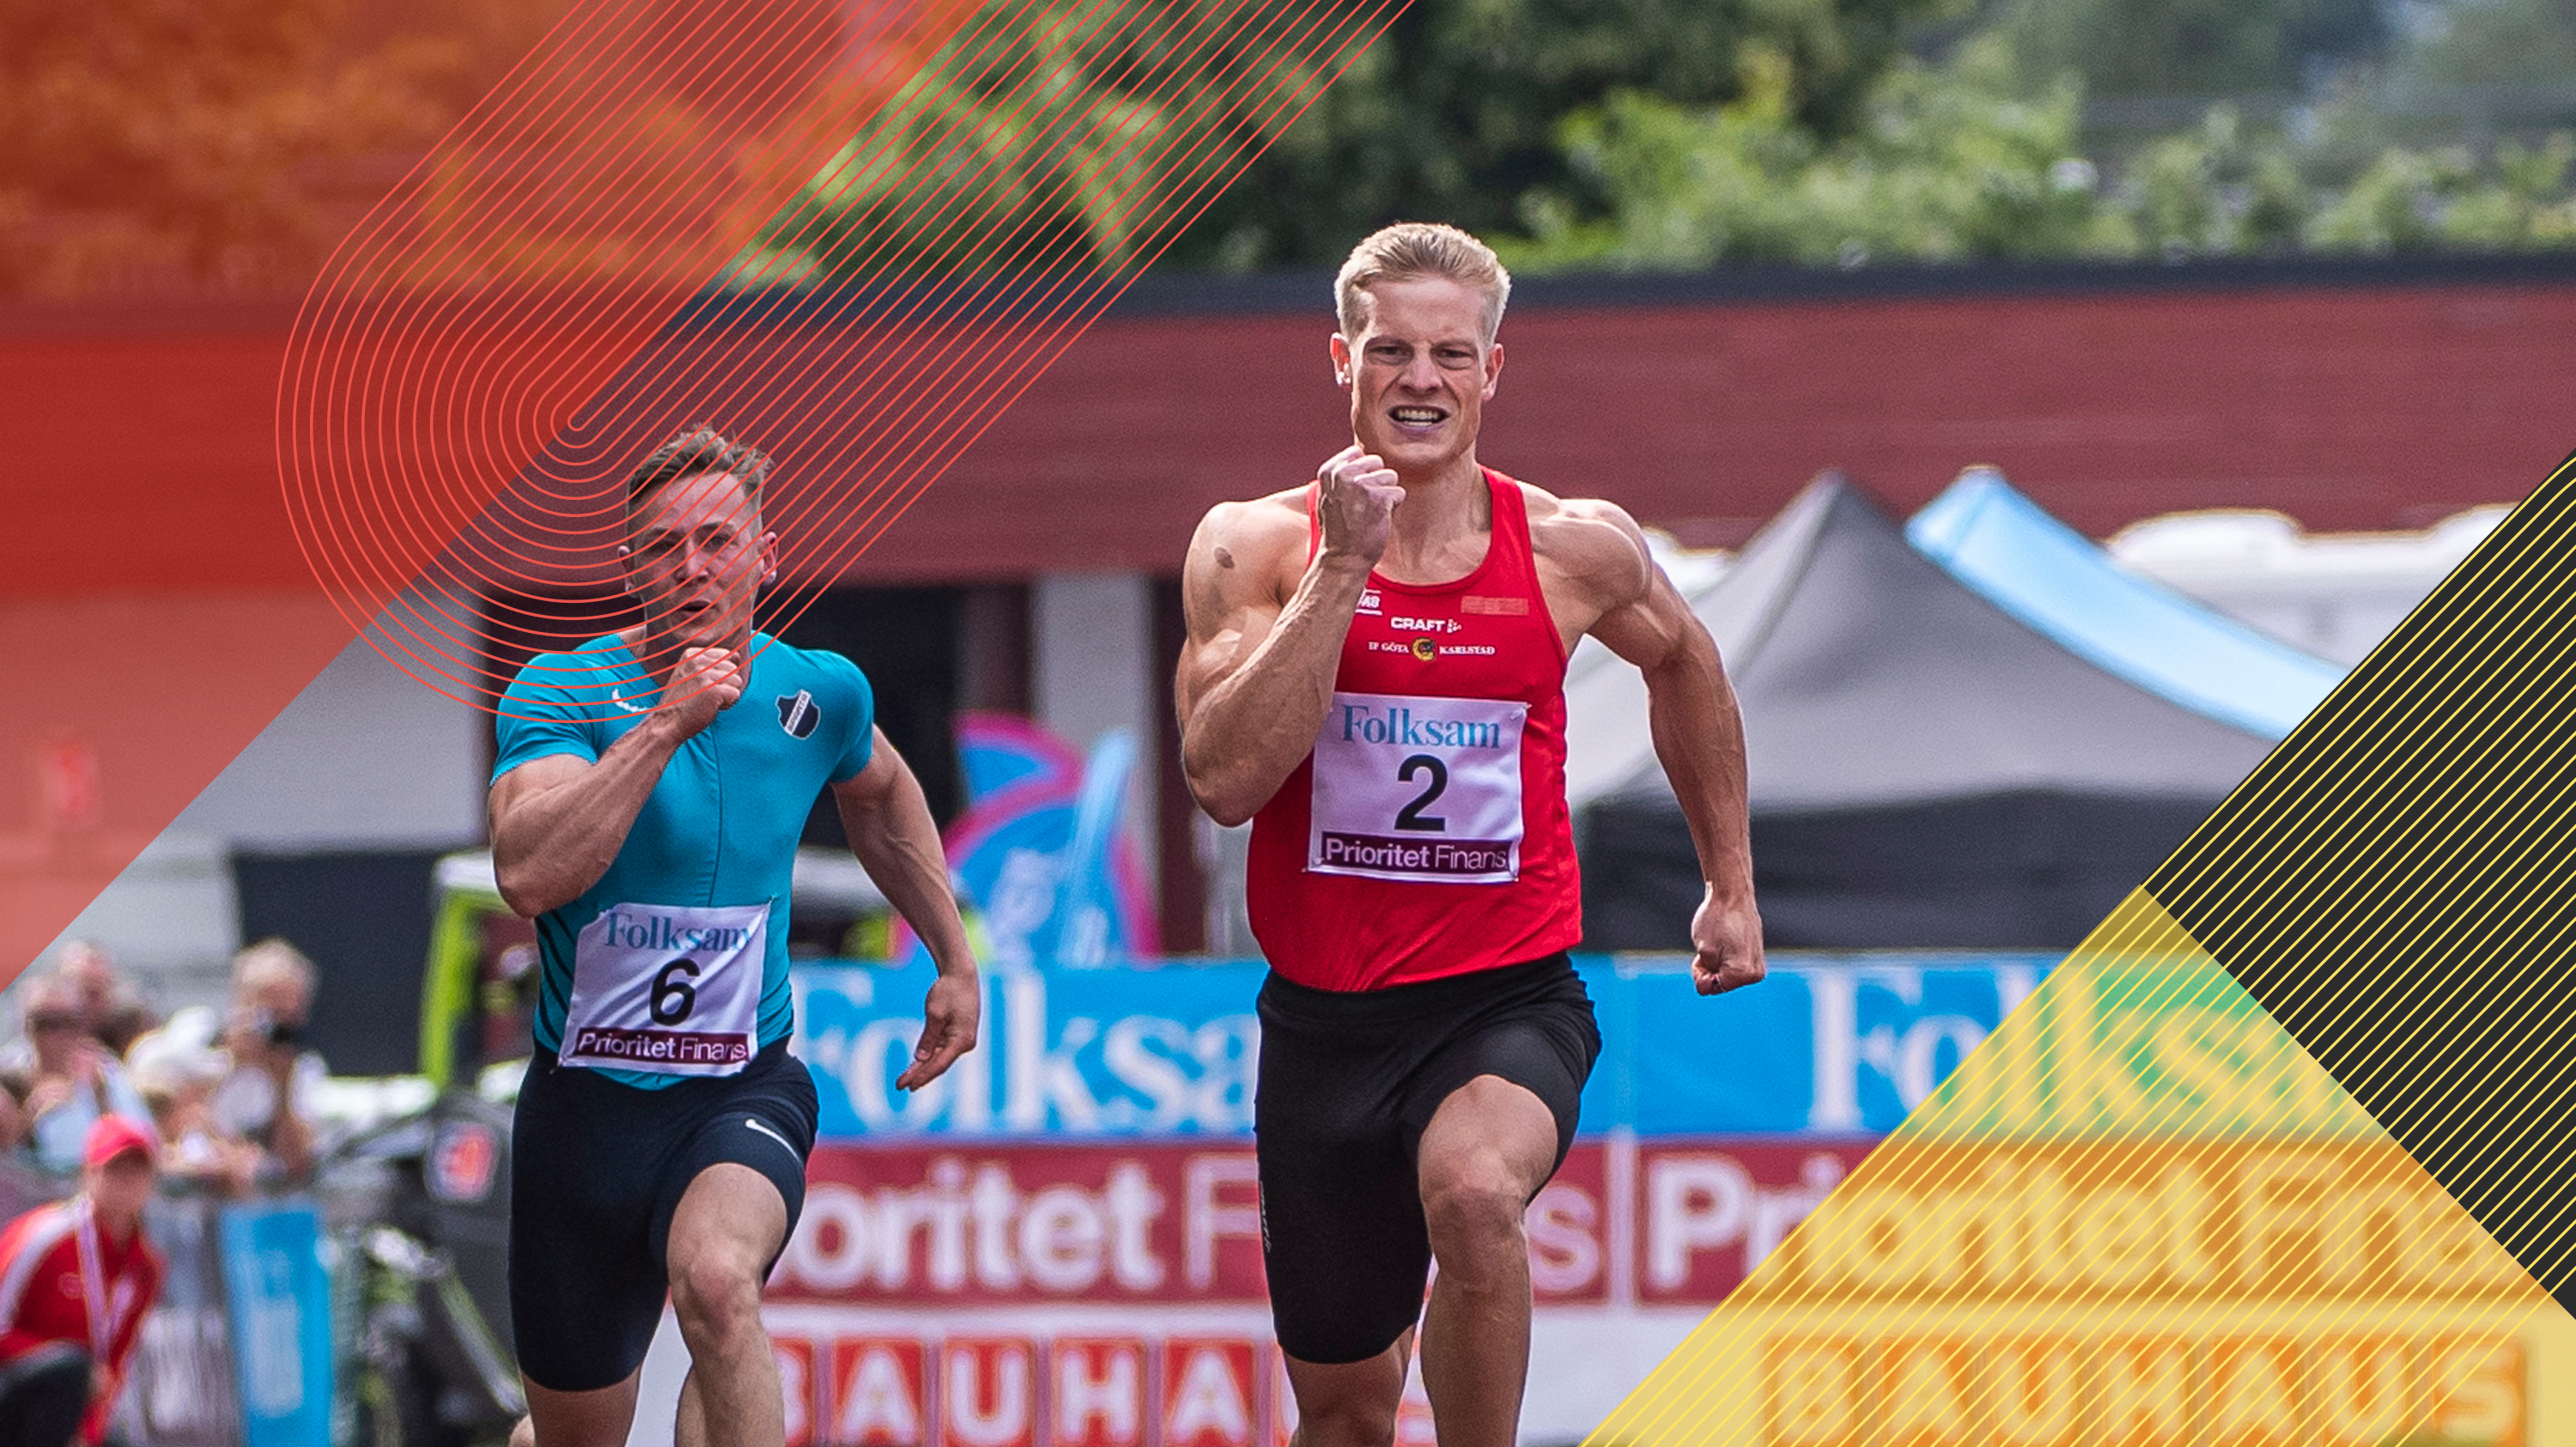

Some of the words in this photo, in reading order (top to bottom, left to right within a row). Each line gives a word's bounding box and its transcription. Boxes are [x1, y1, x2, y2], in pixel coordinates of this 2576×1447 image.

[1391, 617, 1446, 632] CRAFT
[1439, 646, 1496, 655] KARLSTAD
[1343, 705, 1500, 749] Folksam
[1395, 754, 1448, 830] 2
[1327, 839, 1429, 866] Prioritet
[1436, 845, 1505, 867] Finans
[605, 913, 749, 951] Folksam
[650, 959, 700, 1026] 6
[579, 1034, 677, 1059] Prioritet
[792, 969, 1258, 1130] Folksa
[1647, 1151, 2217, 1291] Prioritet
[1774, 1346, 2516, 1446] BAUHAUS
